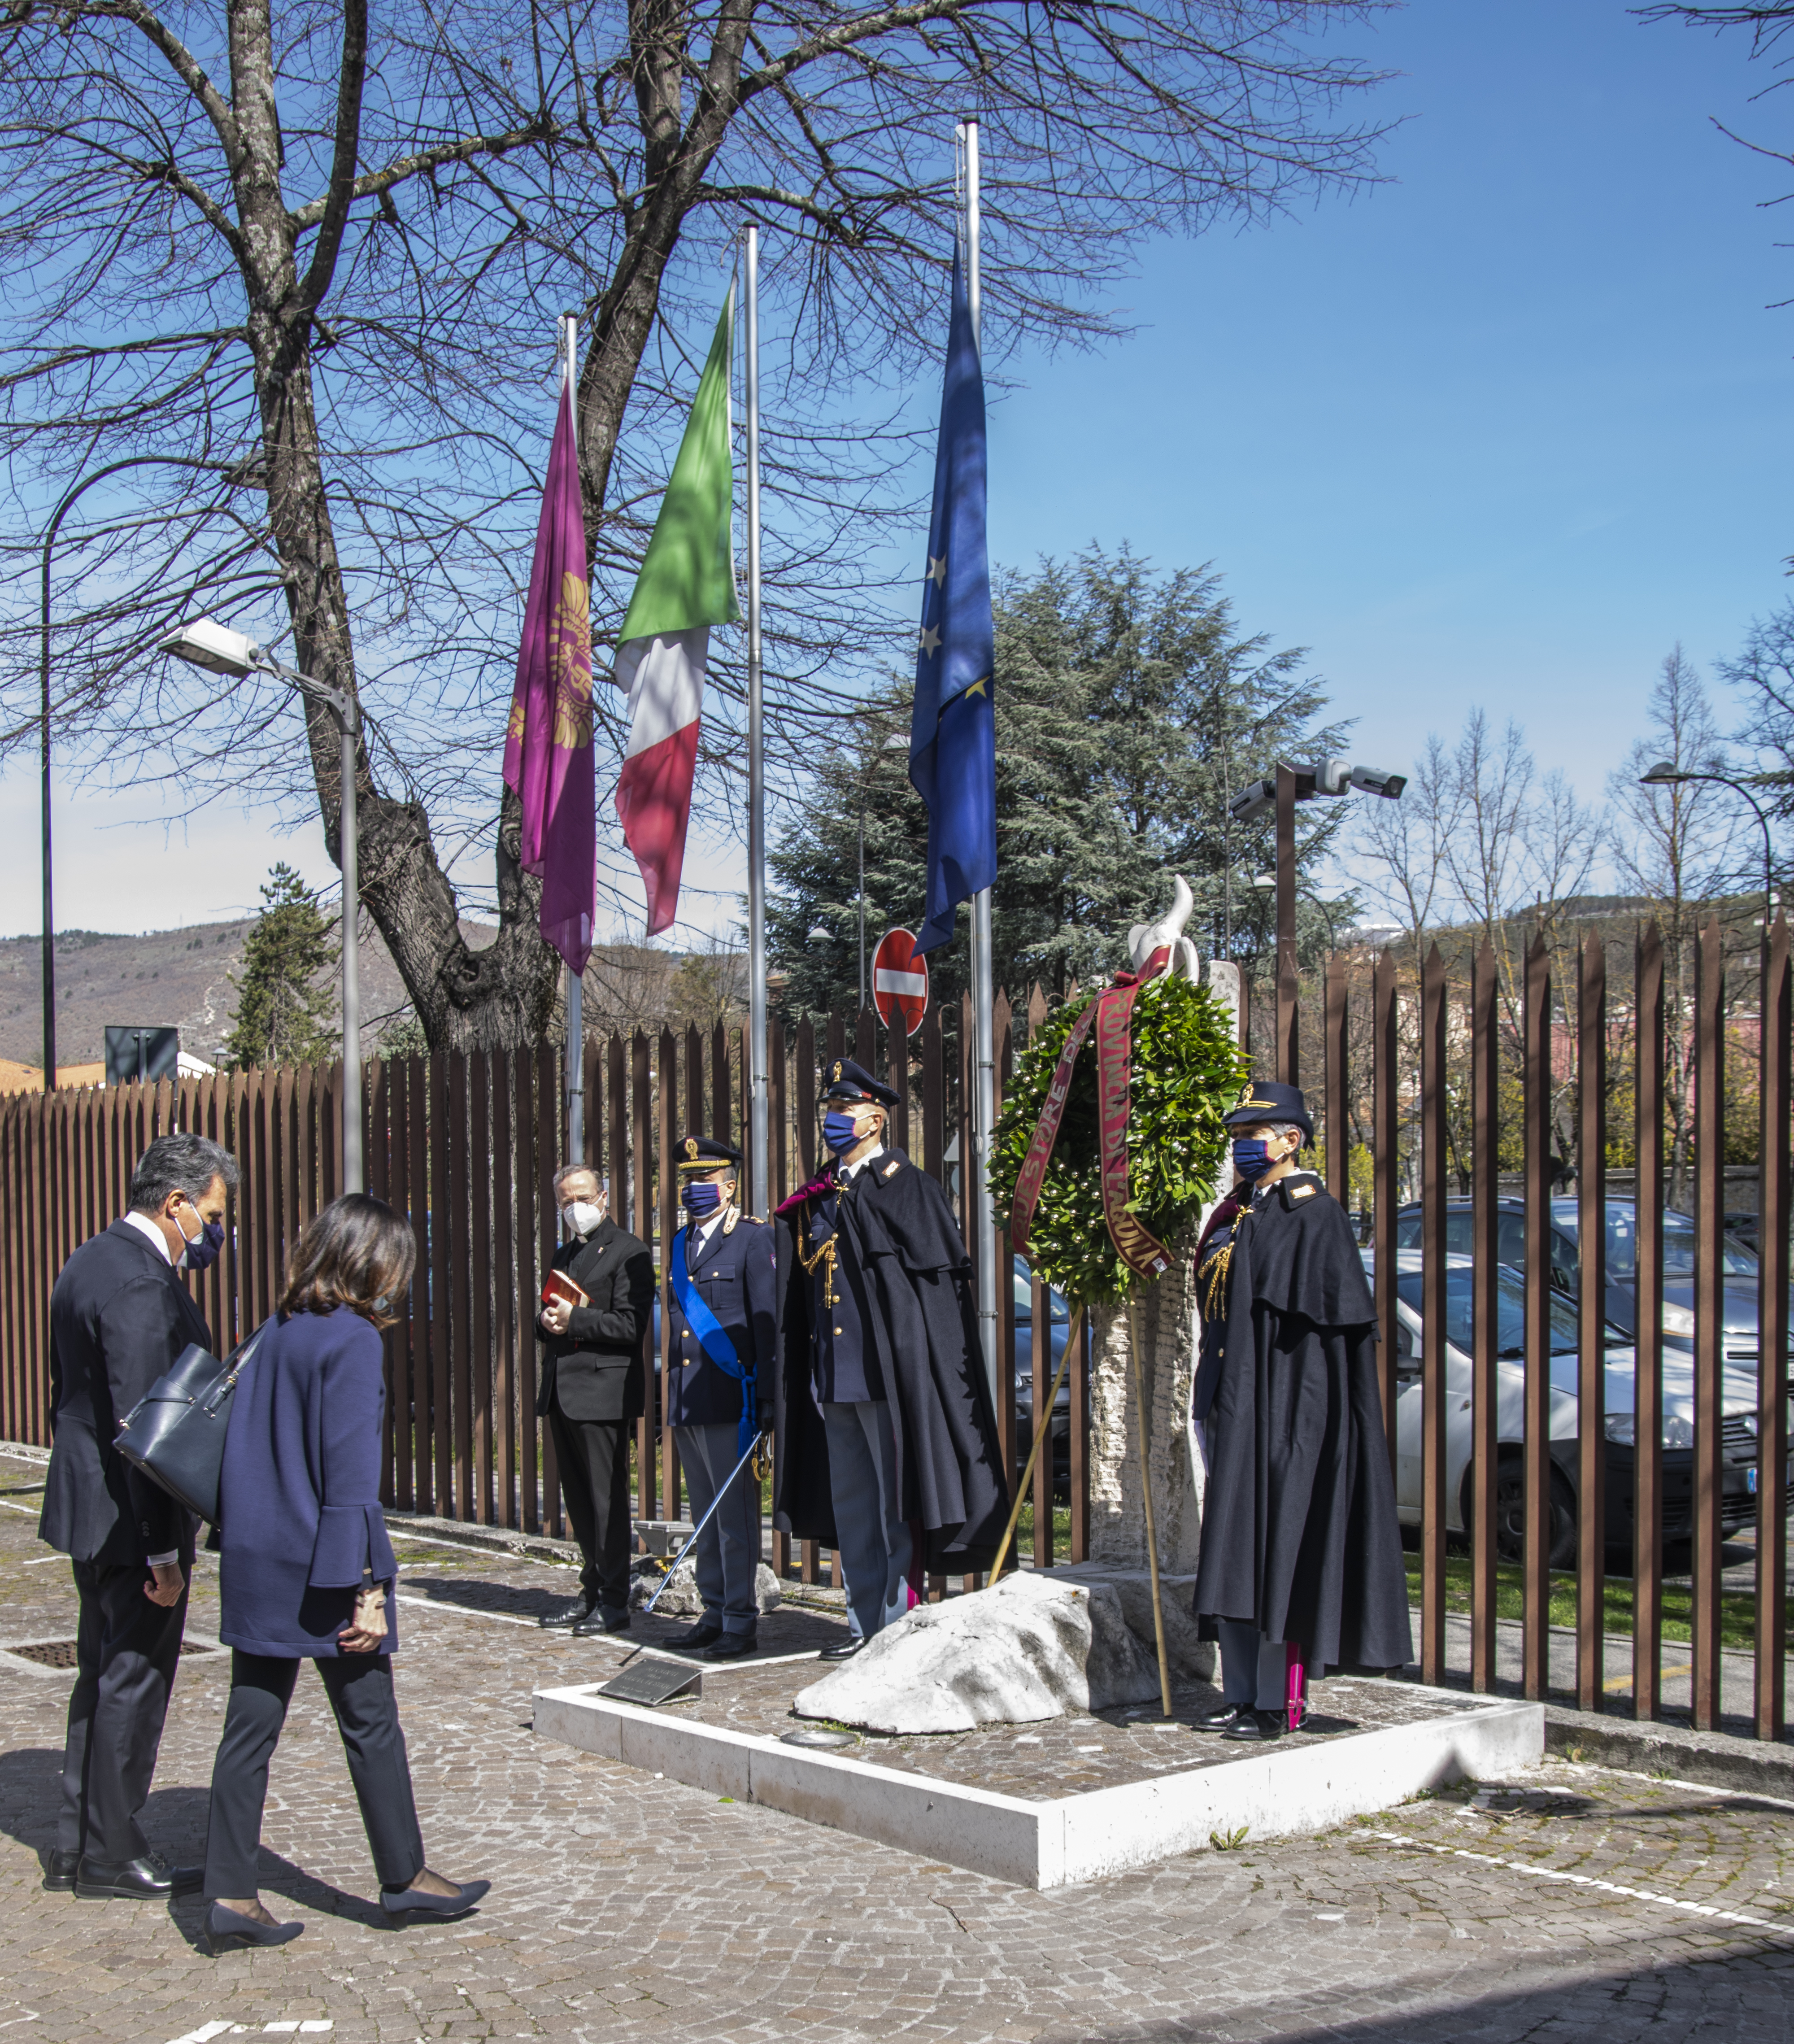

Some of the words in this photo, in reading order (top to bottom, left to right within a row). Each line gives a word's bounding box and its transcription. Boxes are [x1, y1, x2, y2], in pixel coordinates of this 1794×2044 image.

[1103, 989, 1132, 1122] PROVINCIA
[1013, 1081, 1066, 1241] QUESTORE
[1105, 1127, 1125, 1159] DI
[1106, 1172, 1161, 1269] L'AQUILA
